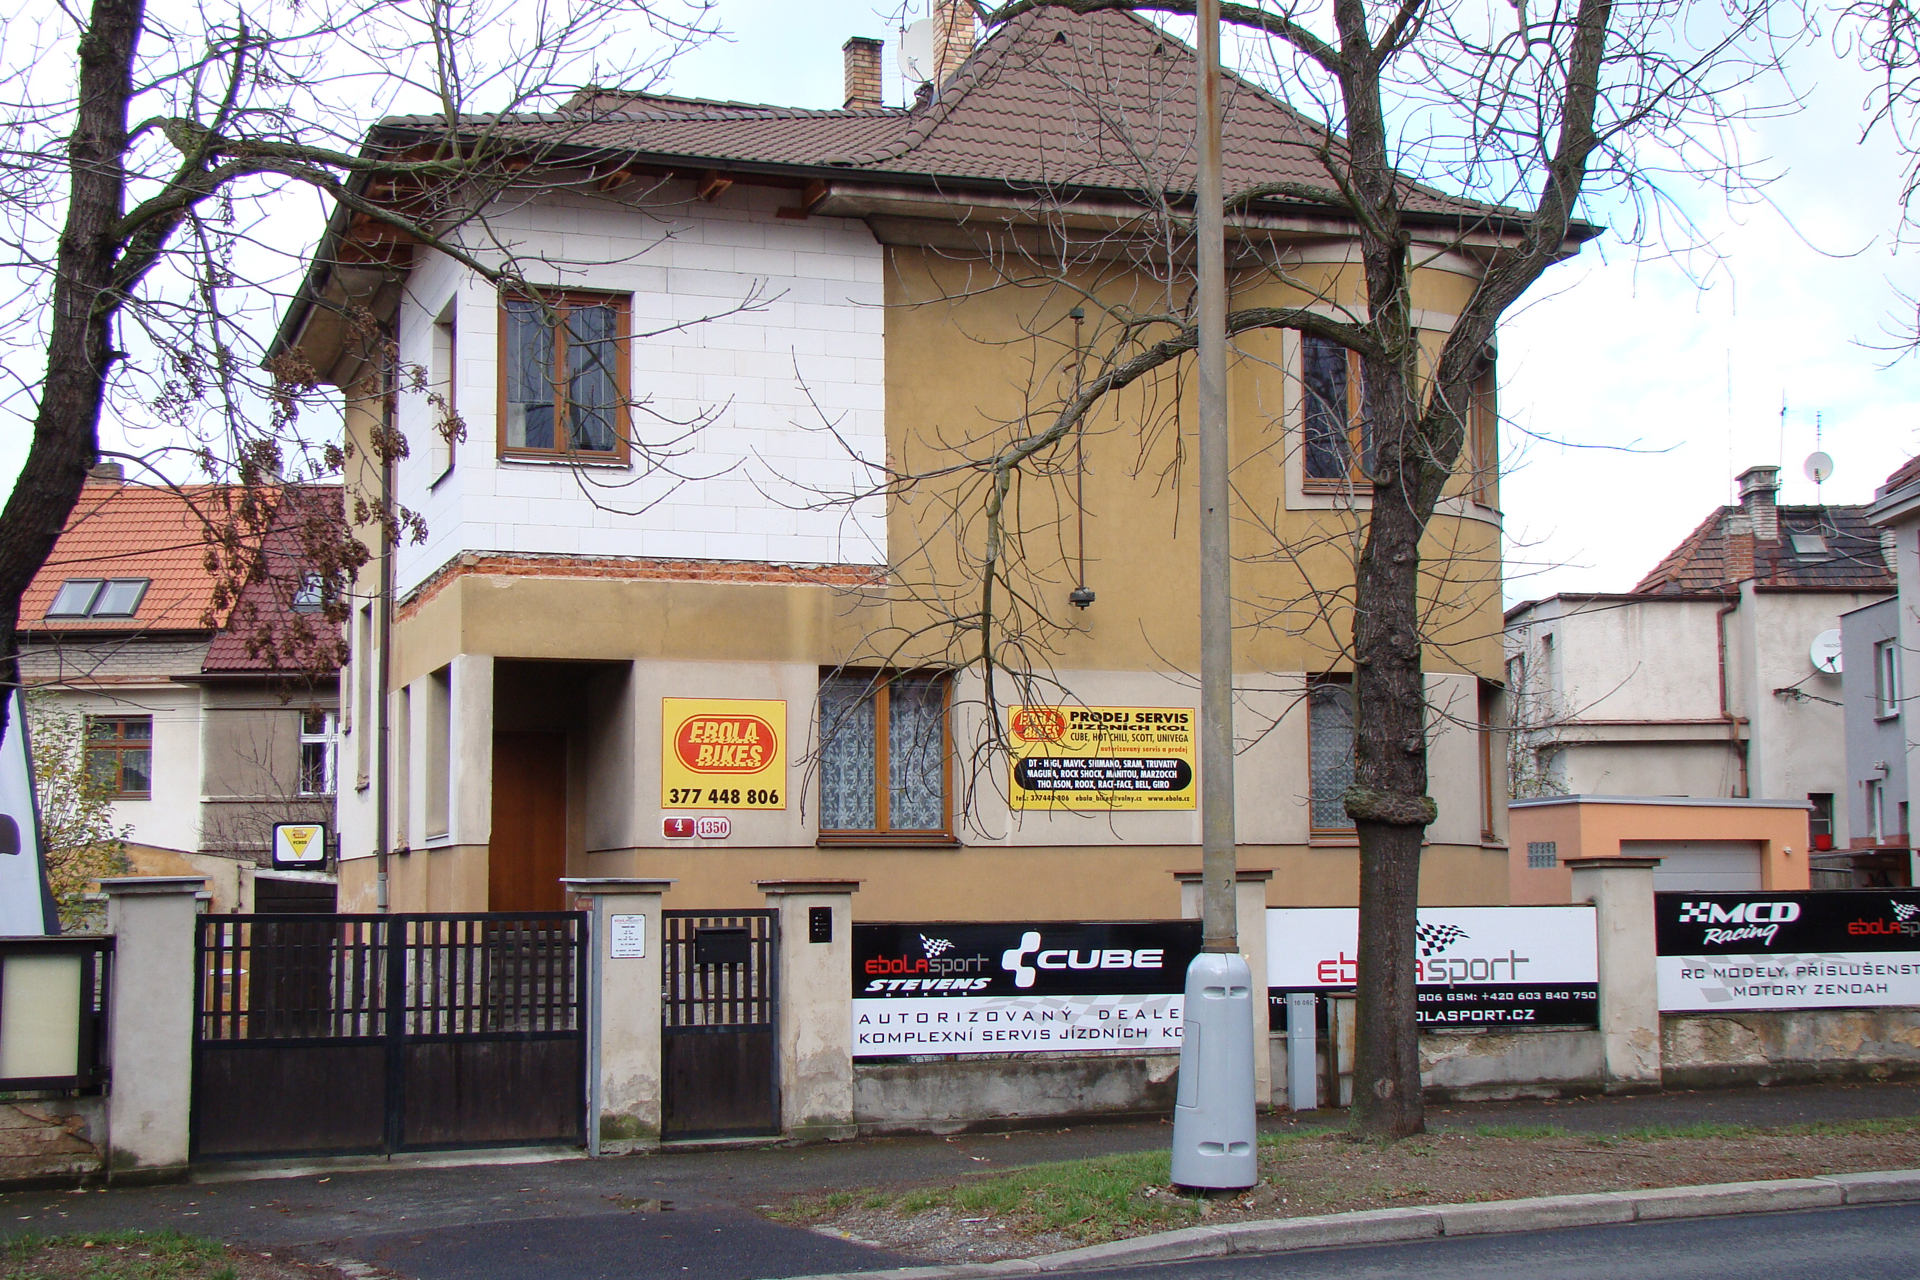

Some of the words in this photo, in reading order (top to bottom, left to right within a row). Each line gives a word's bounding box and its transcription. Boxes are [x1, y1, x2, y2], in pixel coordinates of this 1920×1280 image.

[1070, 711, 1129, 723] PRODEJ
[1135, 713, 1188, 723] SERVIS
[688, 721, 759, 744] EBOLA
[1070, 722, 1150, 731] JÍZDNÍCH
[1070, 732, 1090, 742] CUBE,
[1093, 733, 1107, 741] HOT
[1131, 733, 1155, 743] SCOTT,
[1157, 733, 1188, 742] UNIVEGA
[695, 745, 763, 767] BIKES
[1168, 746, 1188, 754] prodej
[1028, 759, 1038, 767] DT
[1043, 759, 1062, 769] HGI,
[1063, 759, 1087, 769] MAVIC,
[1123, 759, 1144, 769] SRAM,
[1146, 760, 1178, 768] TRUVATIV
[1060, 769, 1078, 778] ROCK
[1080, 769, 1104, 779] SHOCK,
[1074, 780, 1096, 789] ROOX,
[1135, 780, 1151, 789] BELL,
[1152, 780, 1170, 789] GIRO
[669, 788, 702, 804] 377
[708, 789, 740, 804] 448
[747, 789, 779, 805] 806
[1147, 794, 1190, 802] www.ebola.cz
[674, 819, 683, 832] 4
[700, 821, 727, 833] 1350
[1708, 902, 1801, 924] MCD
[1703, 924, 1780, 946] Racing
[1036, 948, 1164, 969] CUBE
[1681, 968, 1705, 979] RC
[1713, 966, 1789, 979] MODELY,
[1796, 961, 1920, 979] PŘÍSLUŠENST
[864, 977, 993, 991] STEVENS
[1733, 984, 1808, 997] MOTORY
[1815, 983, 1888, 995] ZENOAH
[1418, 993, 1442, 1001] 806
[1446, 993, 1478, 1001] GSM:
[1481, 991, 1514, 1000] +420
[1518, 991, 1541, 1000] 603
[1545, 991, 1569, 1000] 840
[1573, 991, 1597, 999] 750
[858, 1006, 1072, 1025] AUTORIZOVANÝ
[1098, 1008, 1179, 1020] DEALE
[1415, 1008, 1535, 1022] OLASPORT.CZ
[859, 1026, 973, 1044] KOMPLEXNÍ
[982, 1029, 1051, 1041] SERVIS
[1059, 1024, 1148, 1040] JÍZDNÍCH
[1162, 1026, 1183, 1038] KO
